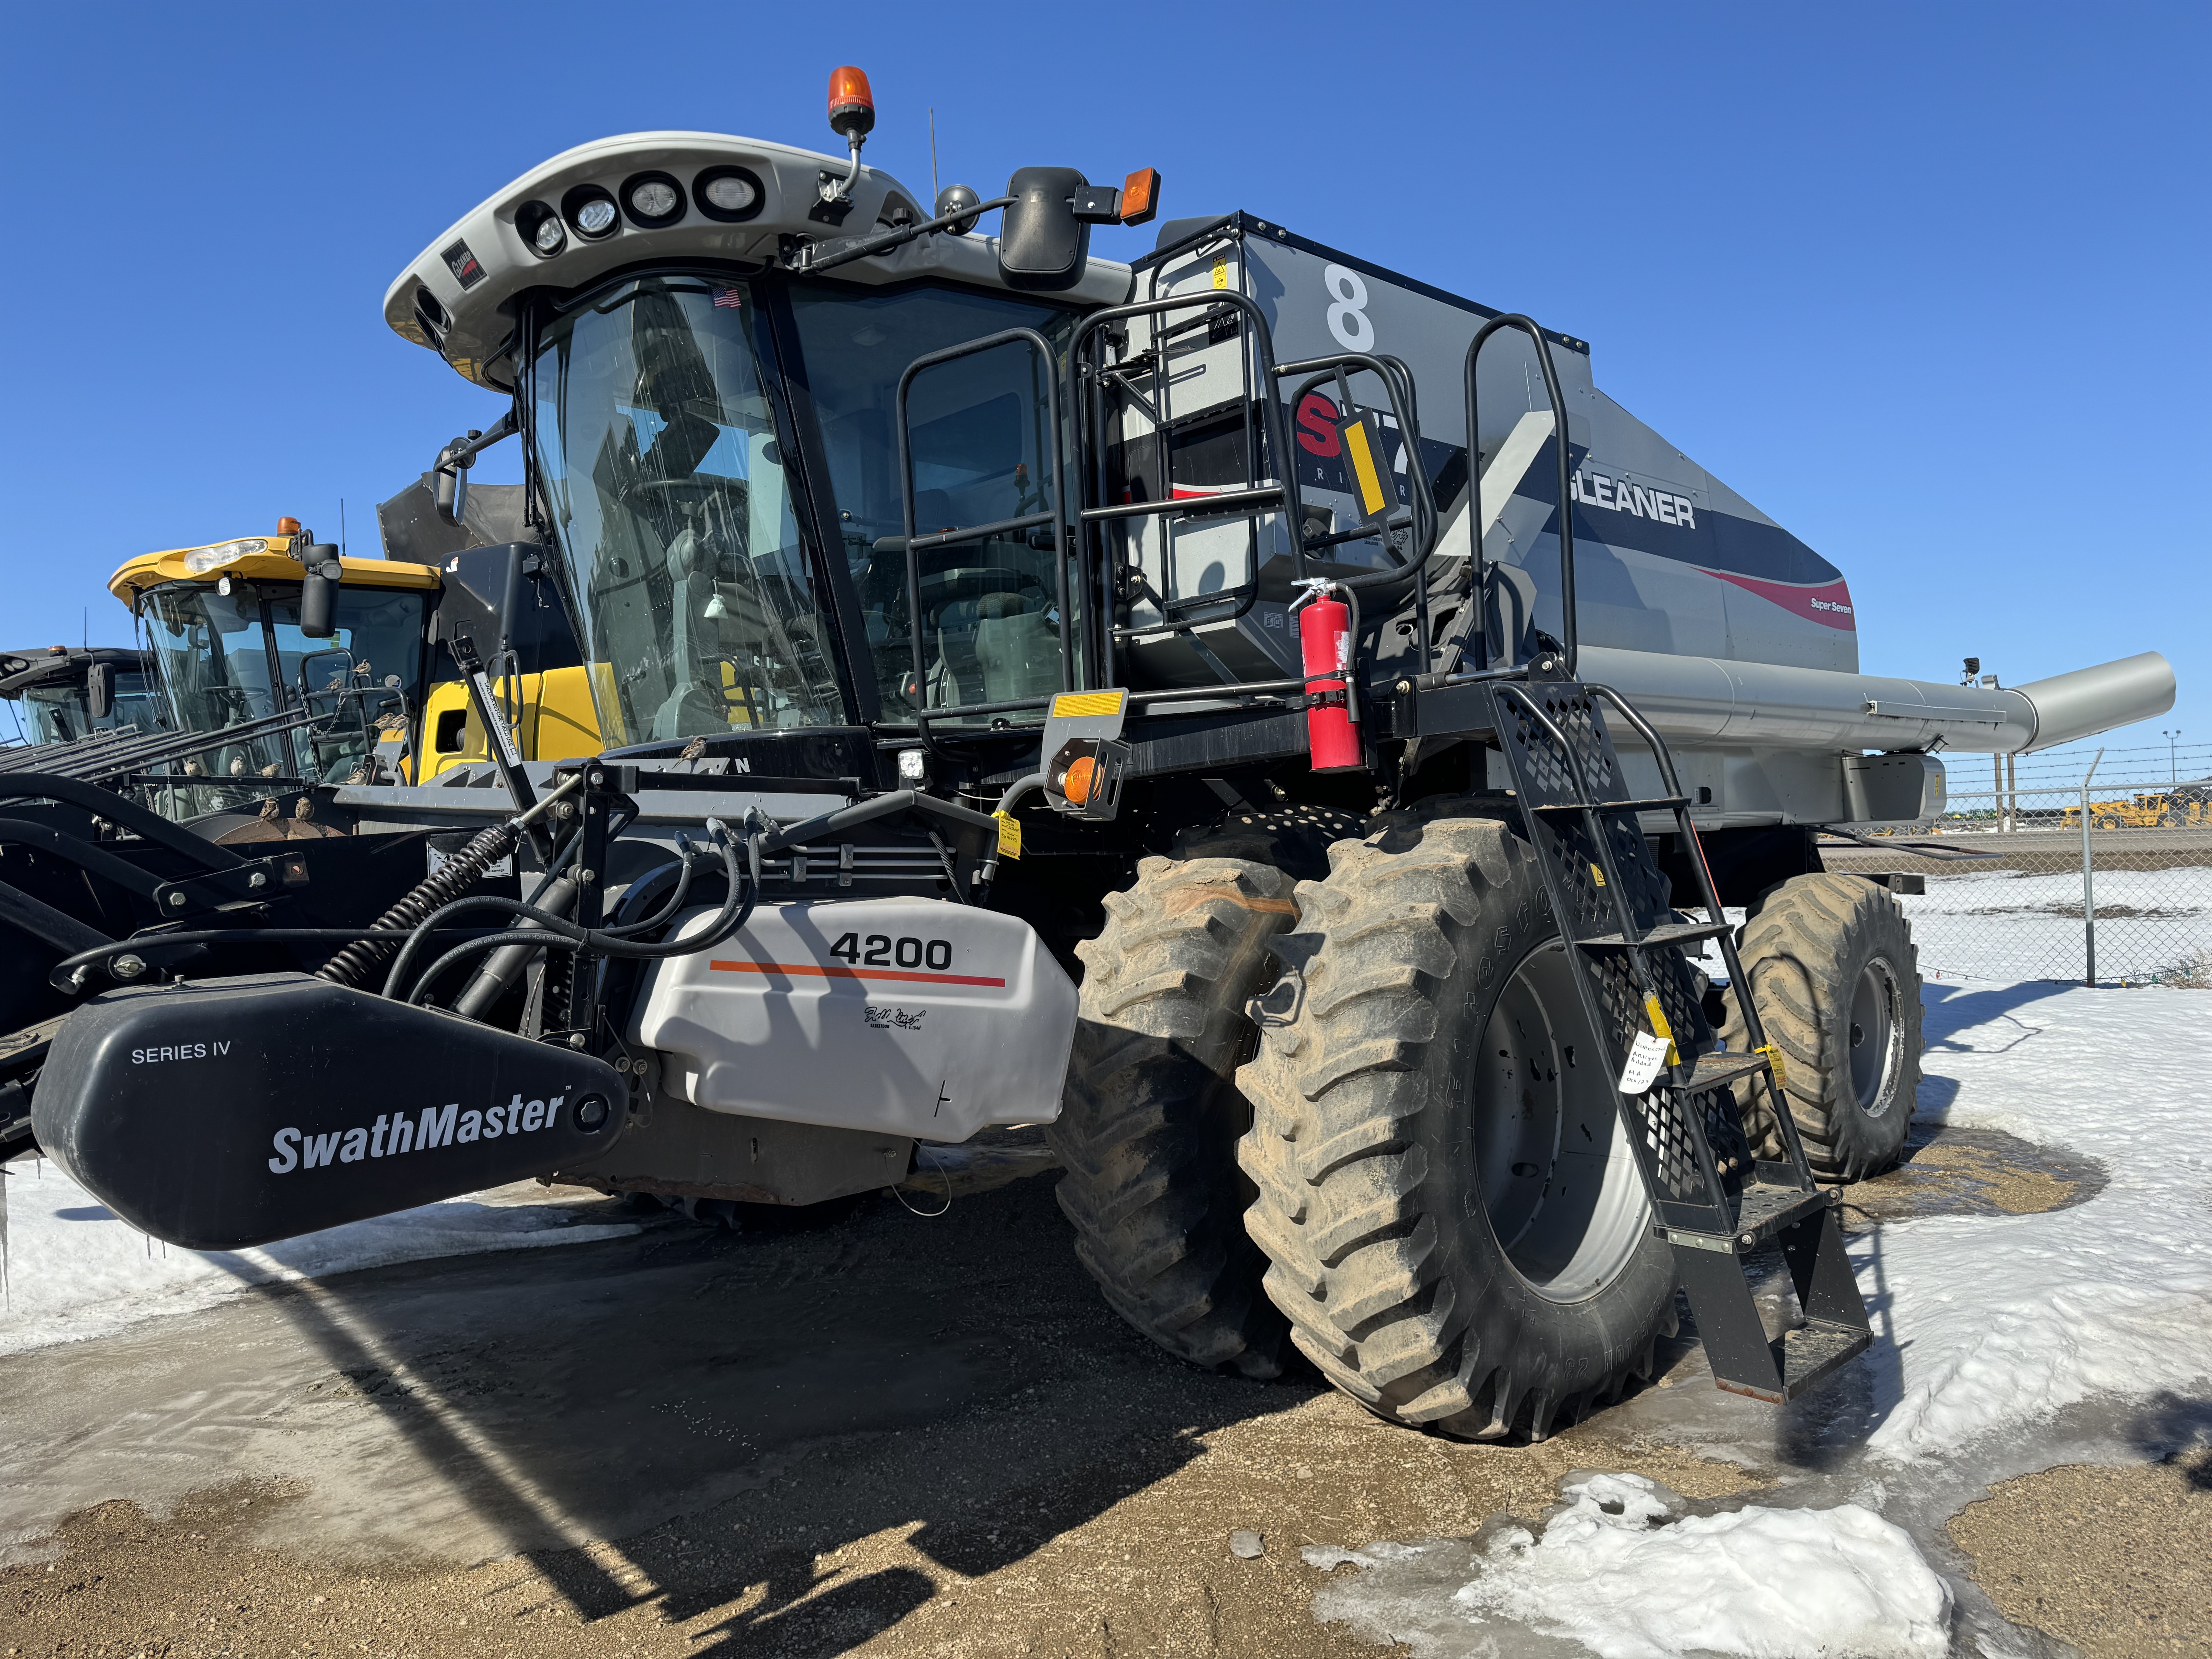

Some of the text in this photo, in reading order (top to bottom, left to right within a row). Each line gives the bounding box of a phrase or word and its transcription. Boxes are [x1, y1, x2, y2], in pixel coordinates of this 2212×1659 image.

[452, 251, 473, 279] GLEANER
[1324, 264, 1374, 353] 8
[1811, 598, 1851, 614] Super Seven
[493, 703, 503, 723] BEFORE
[500, 723, 509, 737] FIELD
[439, 904, 456, 915] MADE
[561, 919, 577, 929] ATLAS
[442, 950, 459, 961] U.S.A.
[465, 940, 483, 949] MADE
[830, 932, 952, 970] 4200
[132, 1041, 231, 1064] SERIES IV
[268, 1094, 564, 1174] SwathMaster
